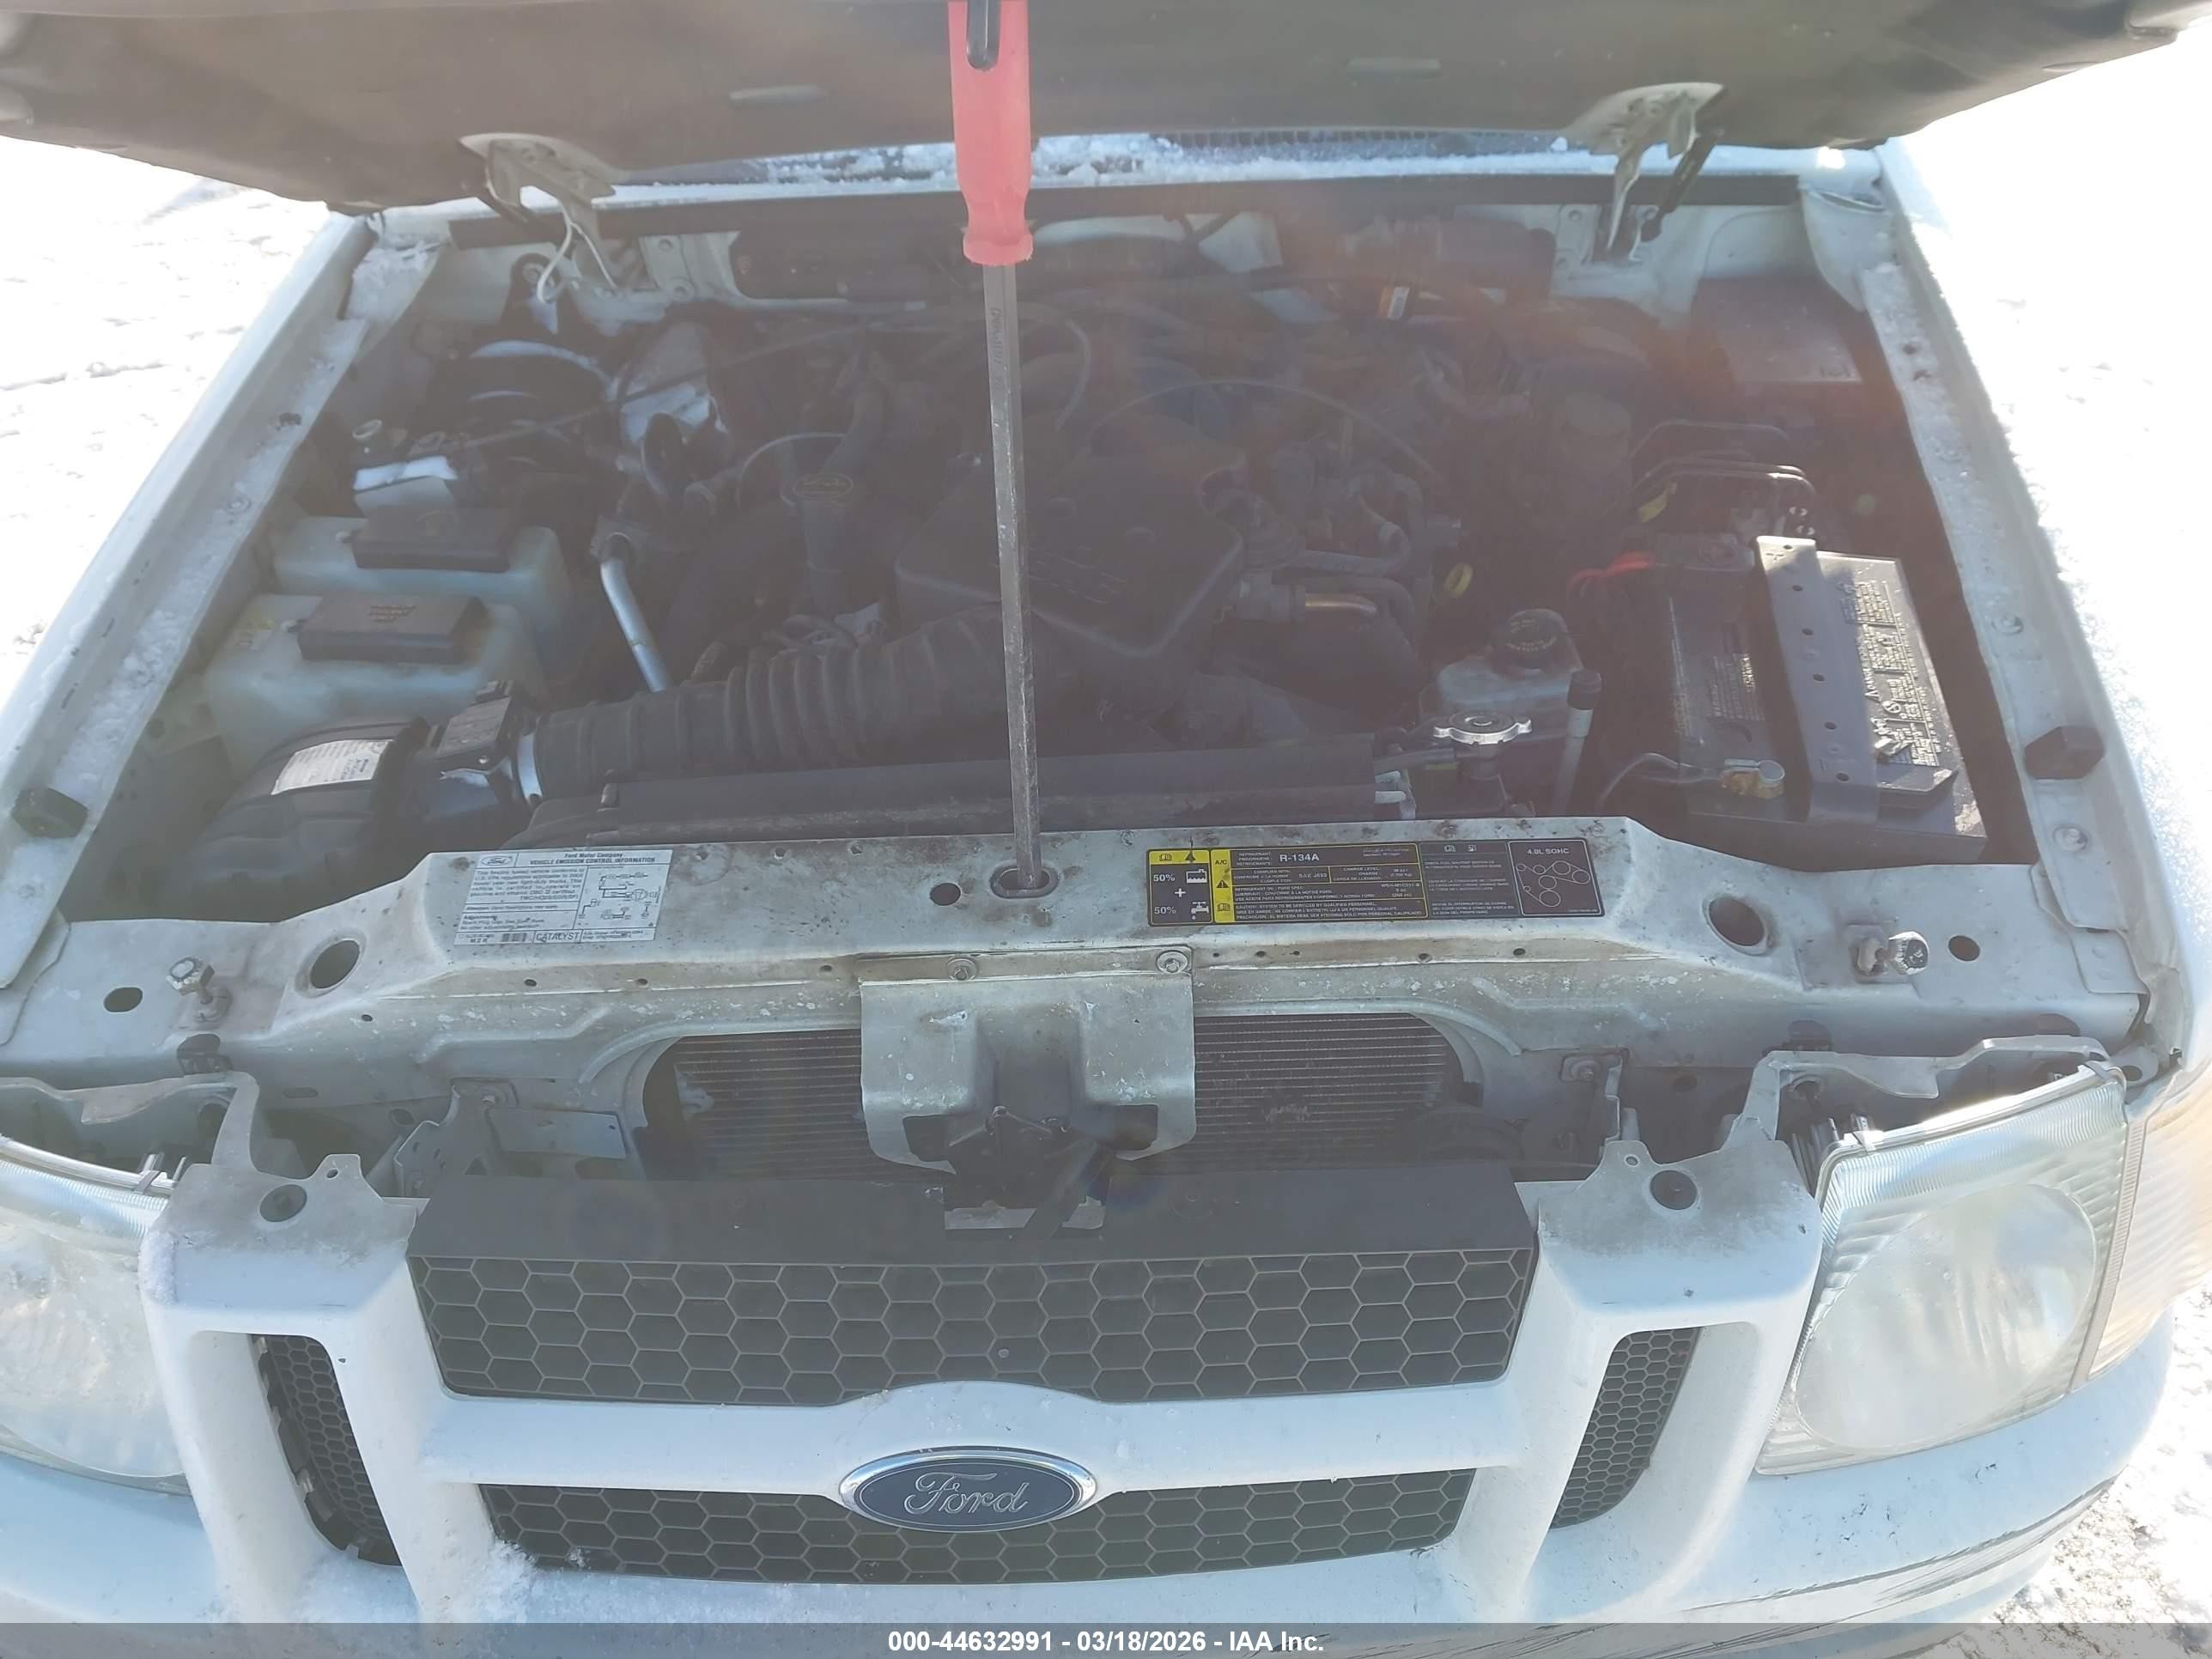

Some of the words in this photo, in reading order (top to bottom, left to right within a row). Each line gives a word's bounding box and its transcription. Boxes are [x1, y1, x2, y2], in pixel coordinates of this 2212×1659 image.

[1279, 853, 1320, 862] R-134A
[1153, 873, 1176, 882] 50%
[1154, 906, 1176, 915] 50%
[535, 932, 580, 942] CATALYST
[902, 1470, 1030, 1515] Ford
